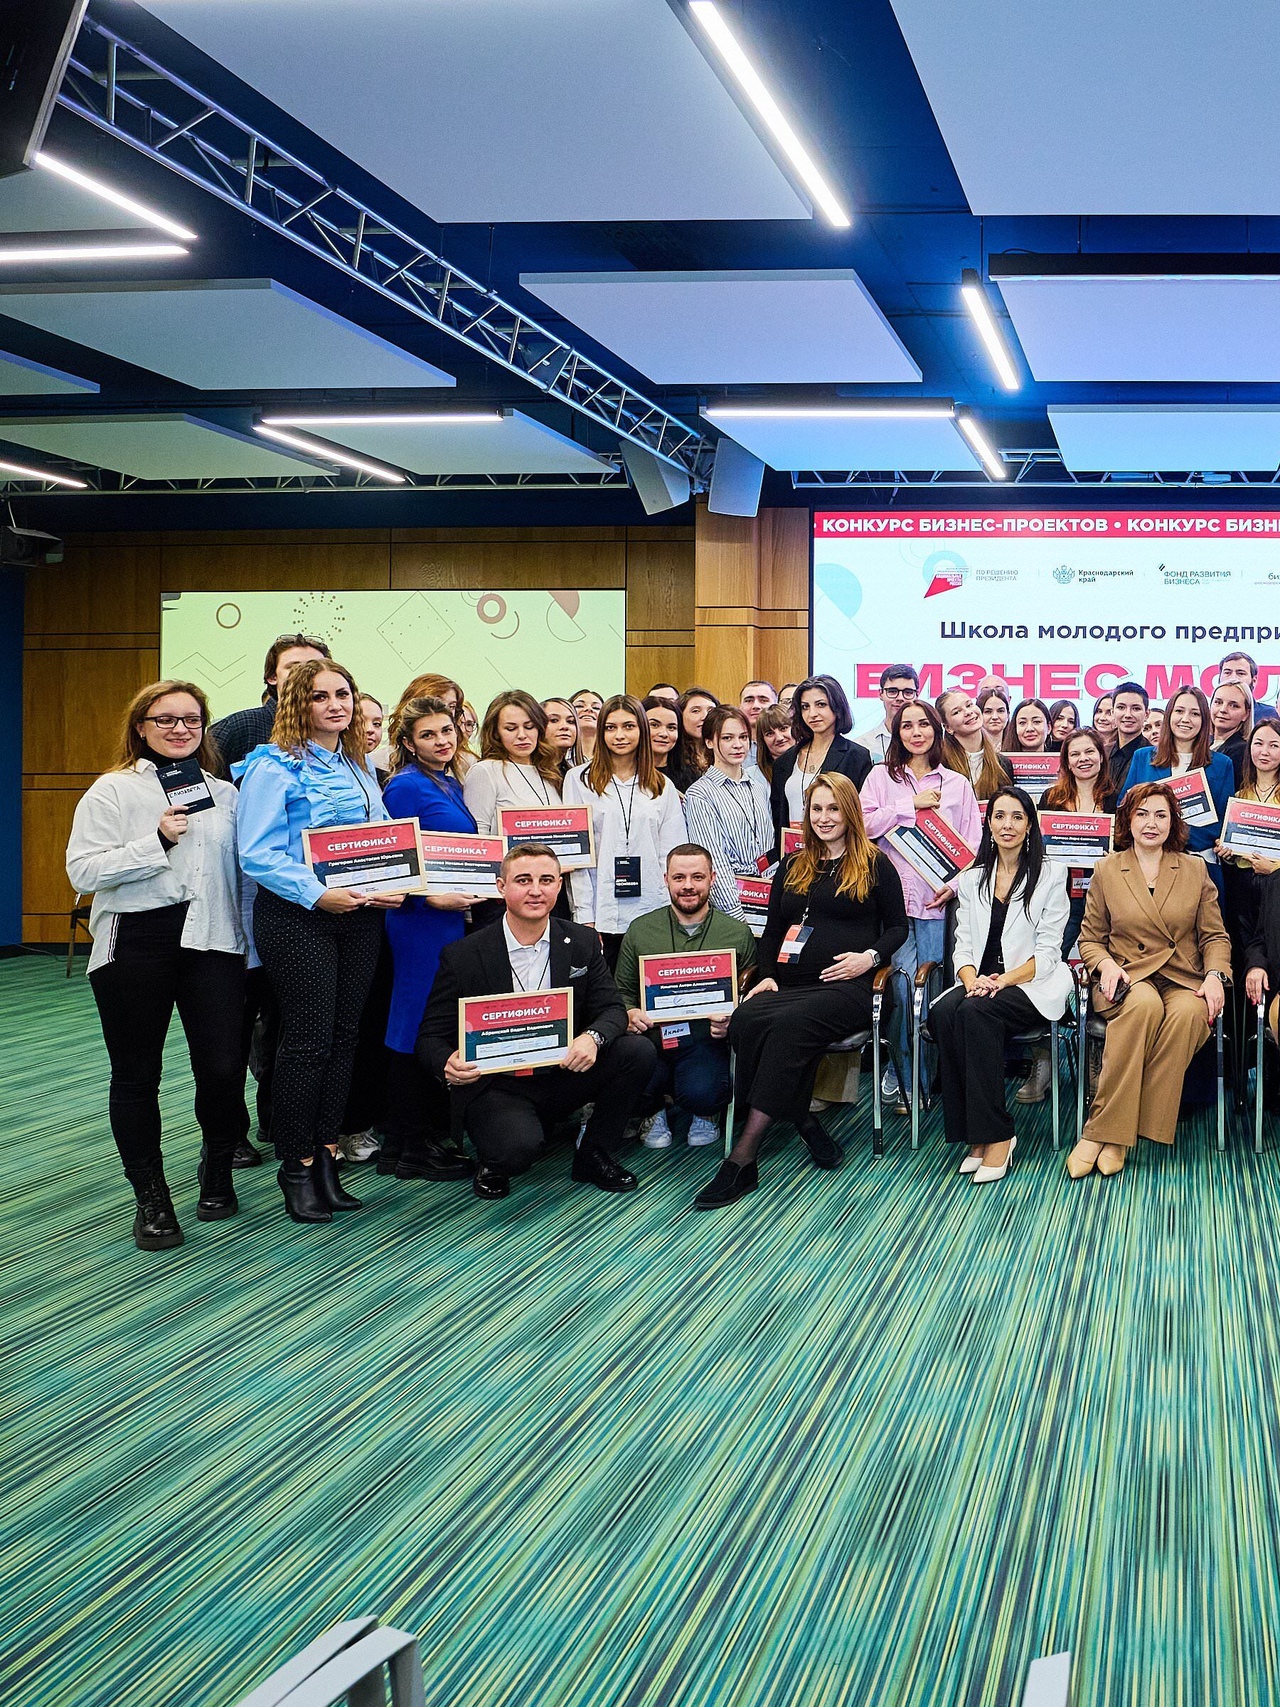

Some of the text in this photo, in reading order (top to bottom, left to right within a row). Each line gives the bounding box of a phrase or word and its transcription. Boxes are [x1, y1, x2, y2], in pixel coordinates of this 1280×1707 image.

[823, 518, 914, 532] КОНКУРС
[919, 518, 1108, 533] БИЗНЕС-ПРОЕКТОВ
[1127, 518, 1220, 533] КОНКУРС
[1078, 569, 1134, 577] Краснодарский
[1163, 570, 1232, 578] ФОНД РАЗВИТИЯ
[1078, 576, 1096, 584] край
[940, 621, 1028, 639] Школа
[1038, 624, 1166, 642] молодого
[514, 819, 573, 828] СЕРТИФИКАТ
[1051, 823, 1099, 831] СЕРТИФИКАТ
[924, 819, 961, 857] СЕРТИФИКАТ
[327, 836, 398, 852] СЕРТИФИКАТ
[424, 845, 488, 855] СЕРТИФИКАТ
[658, 965, 717, 977] СЕРТИФИКАТ
[481, 1006, 551, 1021] СЕРТИФИКАТ
